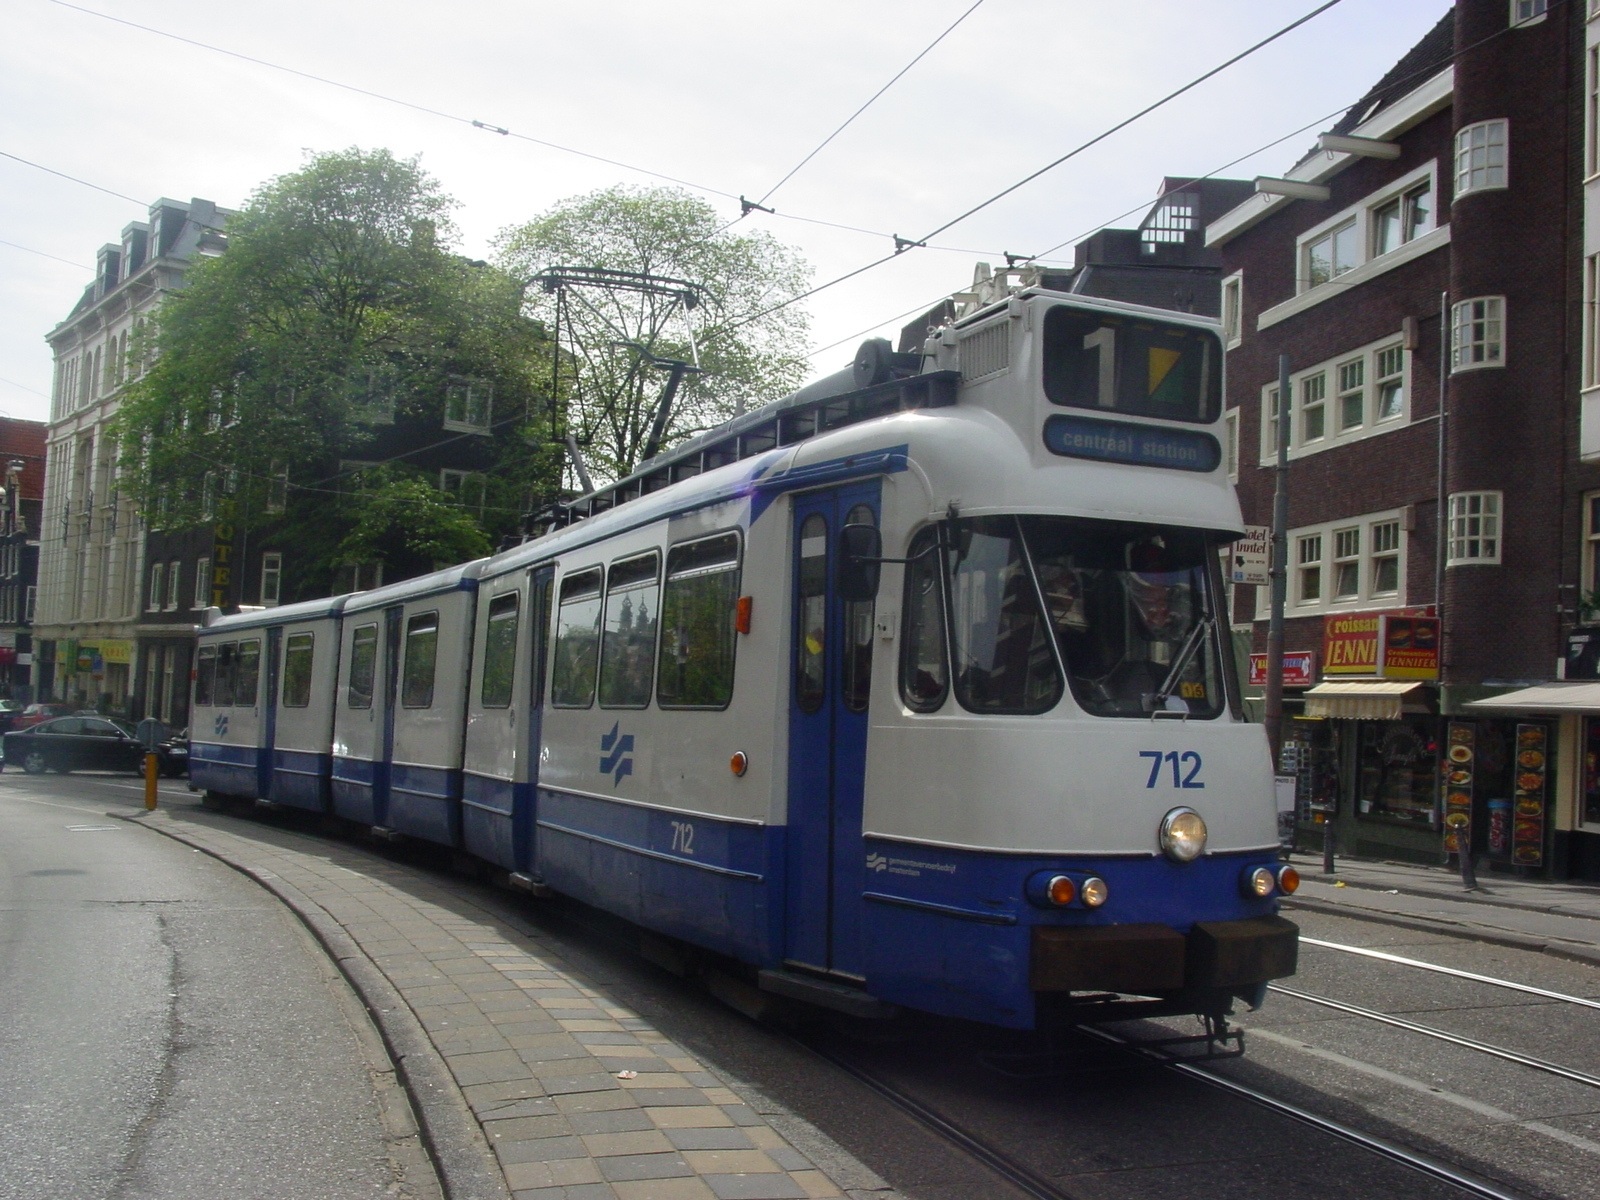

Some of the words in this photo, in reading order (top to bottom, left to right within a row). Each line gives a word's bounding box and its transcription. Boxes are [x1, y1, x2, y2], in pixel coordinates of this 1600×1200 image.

[1083, 327, 1116, 408] 1
[1063, 432, 1133, 454] centraal
[1143, 441, 1198, 460] station
[1235, 540, 1267, 554] Inntel
[1246, 528, 1266, 541] otel
[1386, 656, 1437, 668] JENNIFER
[1139, 750, 1205, 789] 712
[671, 821, 694, 854] 712
